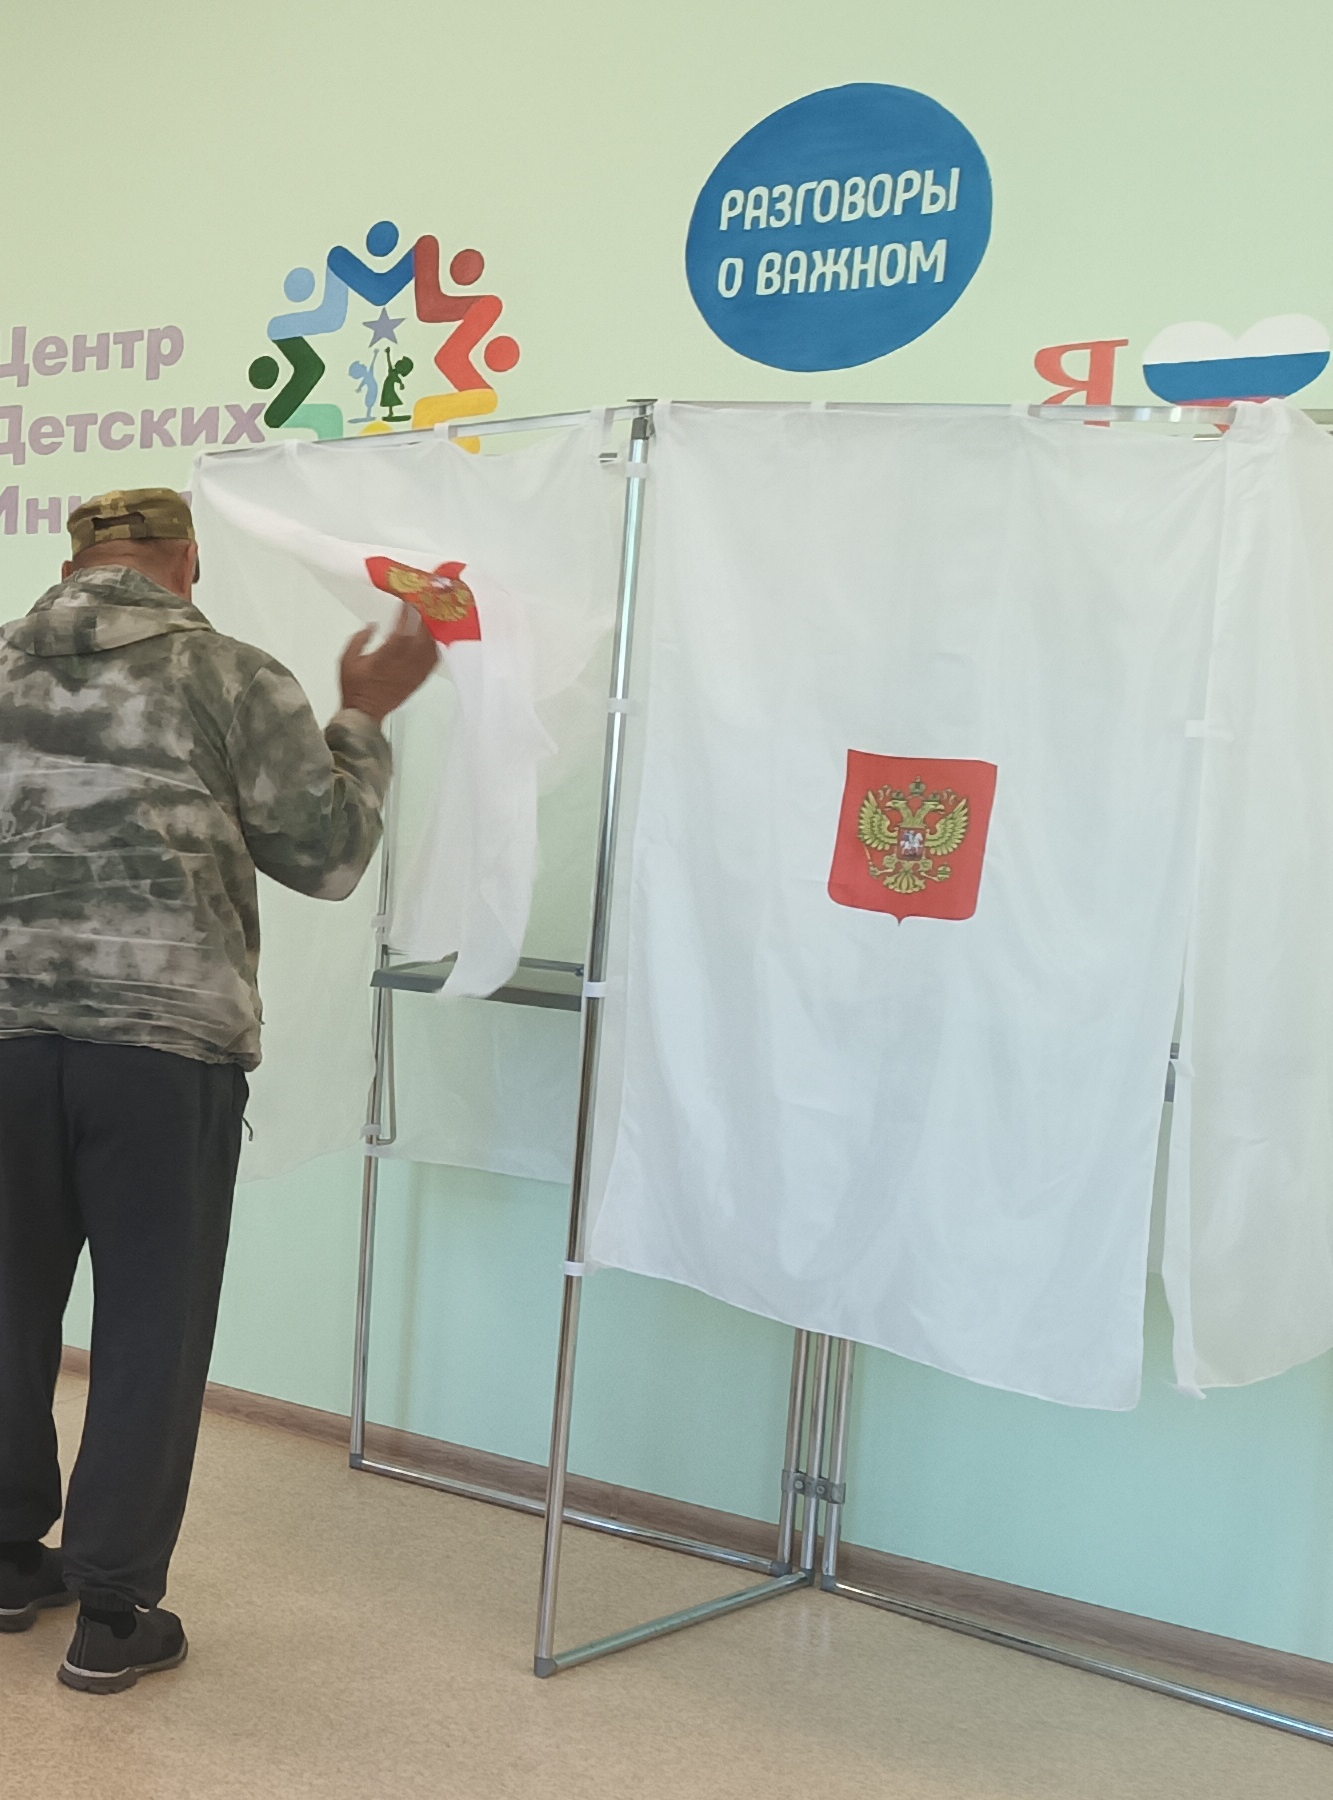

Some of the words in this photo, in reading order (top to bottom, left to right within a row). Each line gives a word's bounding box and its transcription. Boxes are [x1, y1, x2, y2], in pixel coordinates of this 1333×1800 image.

[719, 167, 960, 231] РАЗГОВОРЫ
[717, 257, 744, 298] О
[755, 239, 948, 296] ВАЖНОМ
[1034, 338, 1129, 428] Я
